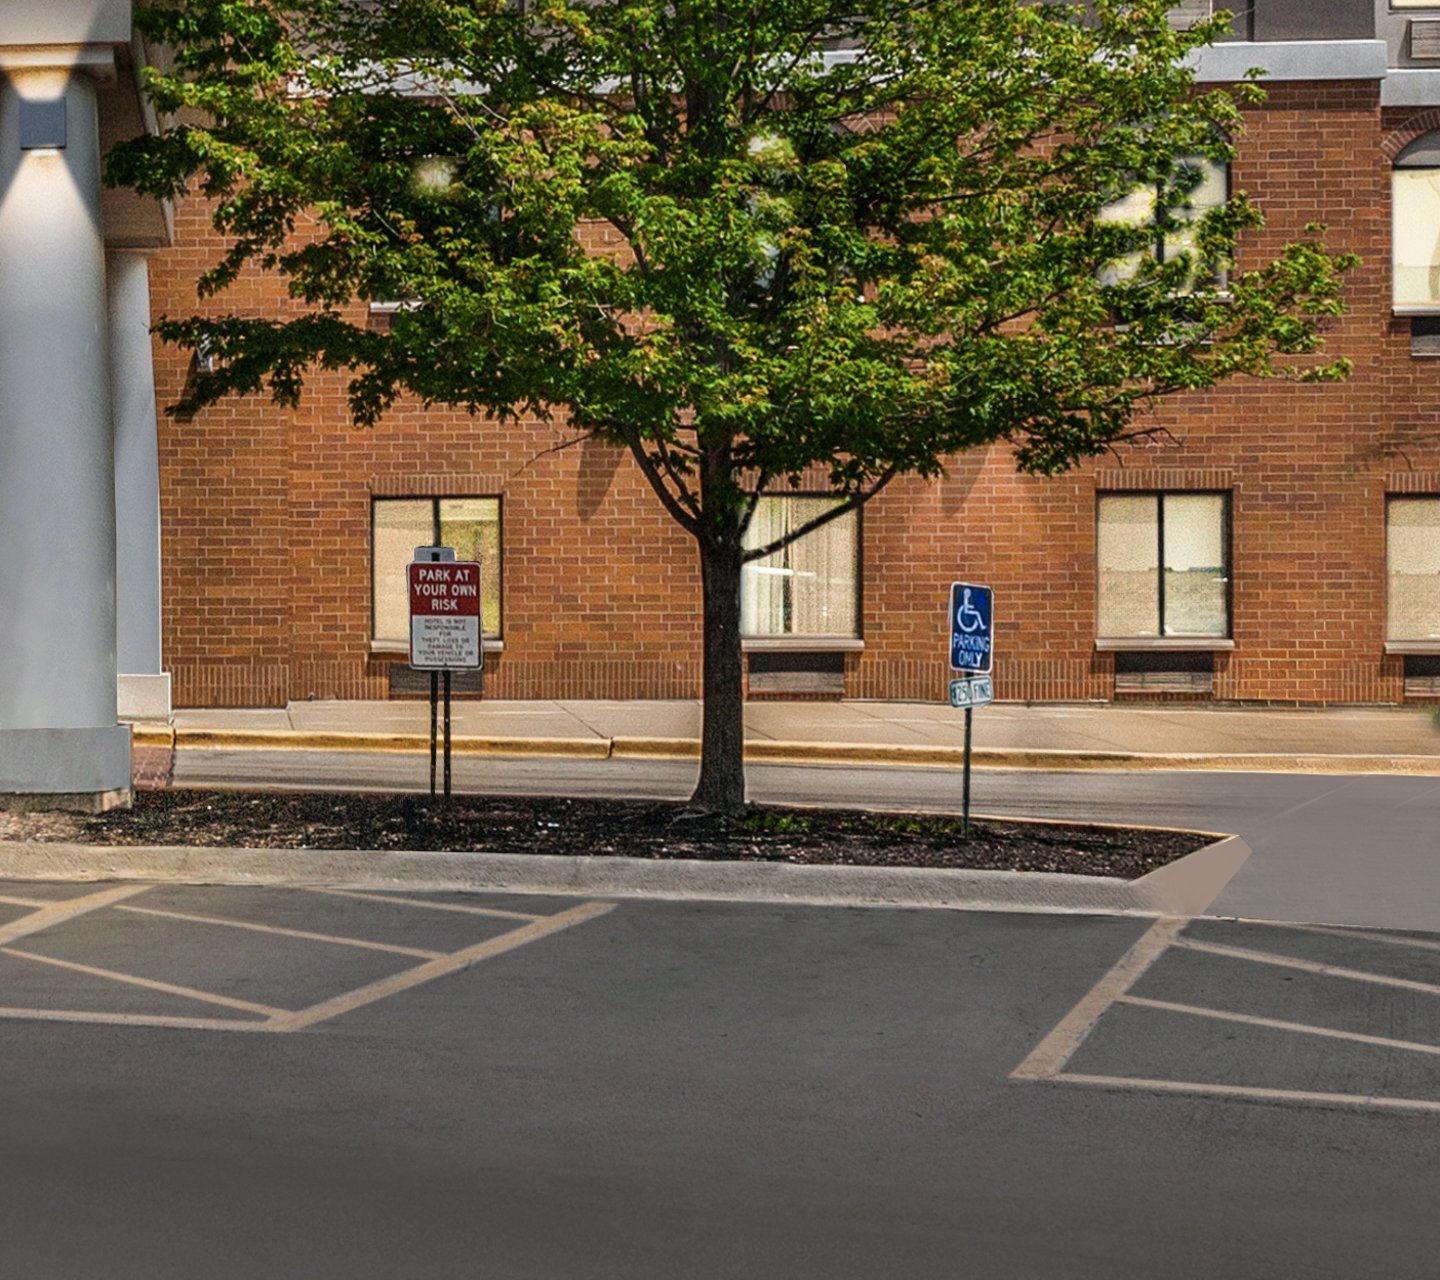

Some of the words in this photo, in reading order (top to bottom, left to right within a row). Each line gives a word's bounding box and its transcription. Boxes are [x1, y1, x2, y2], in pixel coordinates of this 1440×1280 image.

[418, 569, 451, 581] PARK
[454, 569, 470, 581] AT
[414, 584, 447, 596] YOUR
[451, 584, 477, 596] OWN
[431, 598, 458, 610] RISK
[953, 633, 990, 652] PARKING
[958, 649, 983, 668] ONLY
